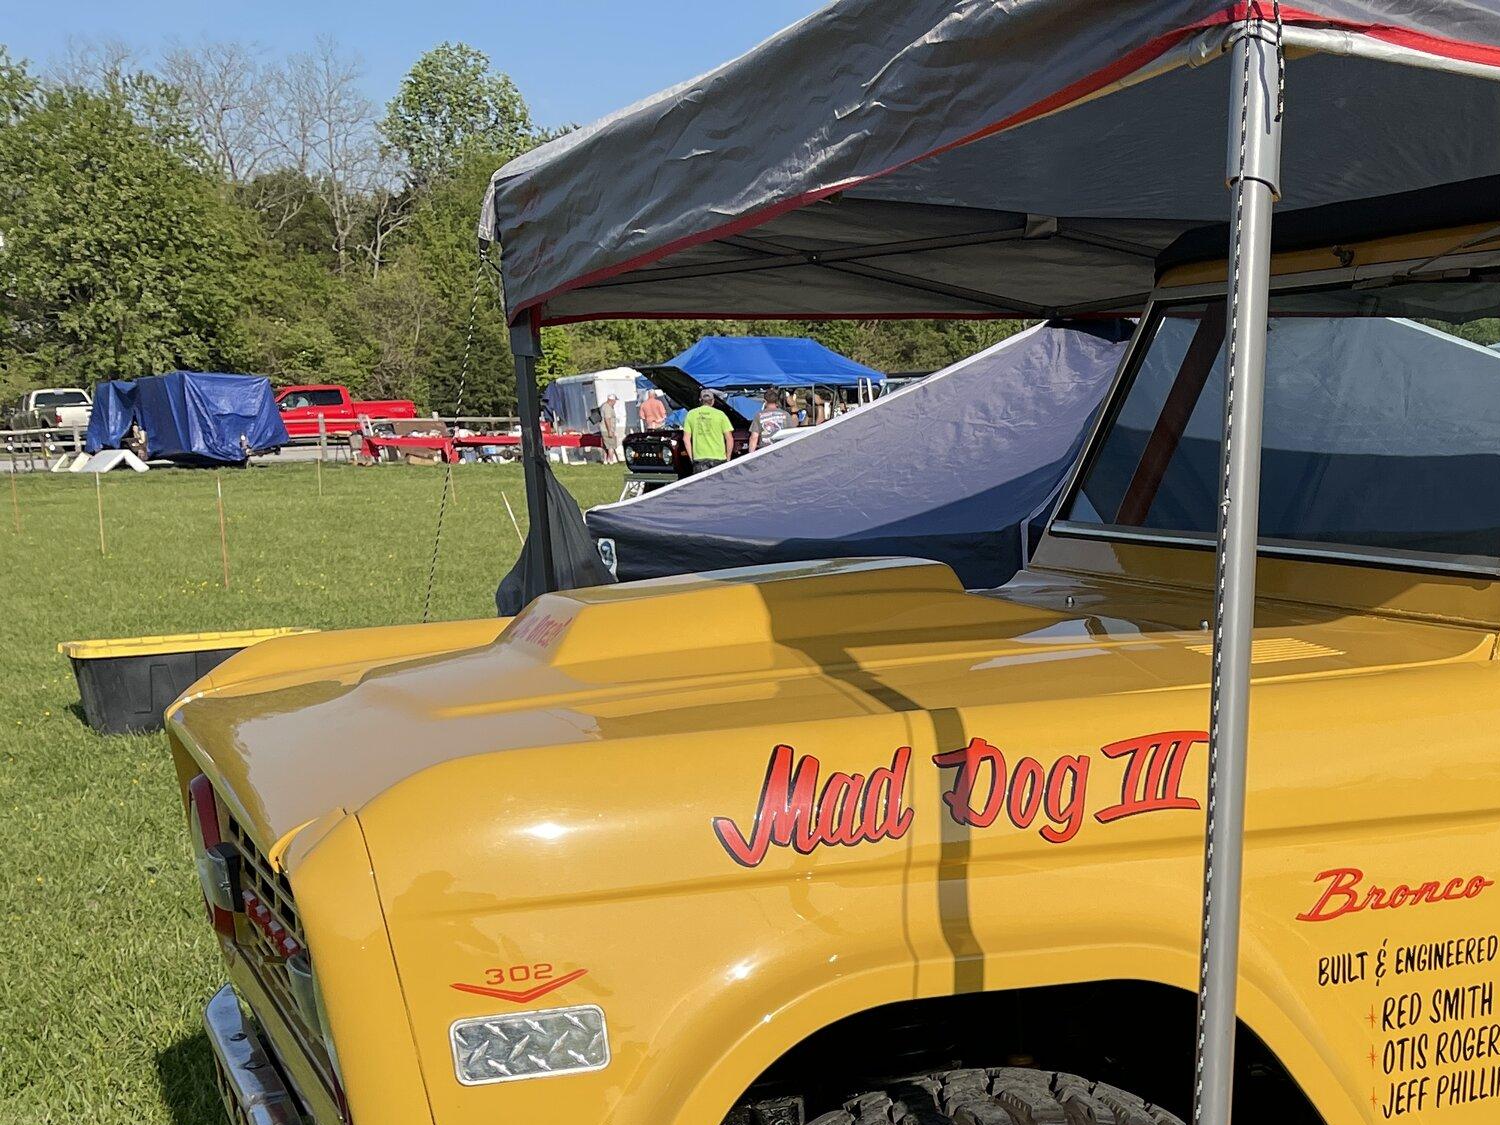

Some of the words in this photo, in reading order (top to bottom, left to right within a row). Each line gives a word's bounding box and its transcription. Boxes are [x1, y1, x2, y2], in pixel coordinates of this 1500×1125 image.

[713, 744, 914, 867] Mad
[933, 738, 1091, 843] Dog
[1094, 731, 1209, 824] III
[1295, 868, 1495, 922] Bronco
[485, 963, 553, 985] 302
[1318, 951, 1369, 986] BUILT
[1375, 938, 1389, 986] &
[1395, 935, 1498, 975] ENGINEERED
[1382, 992, 1422, 1031] RED
[1429, 981, 1493, 1024] SMITH
[1383, 1033, 1428, 1075] OTIS
[1382, 1076, 1430, 1119] JEFF
